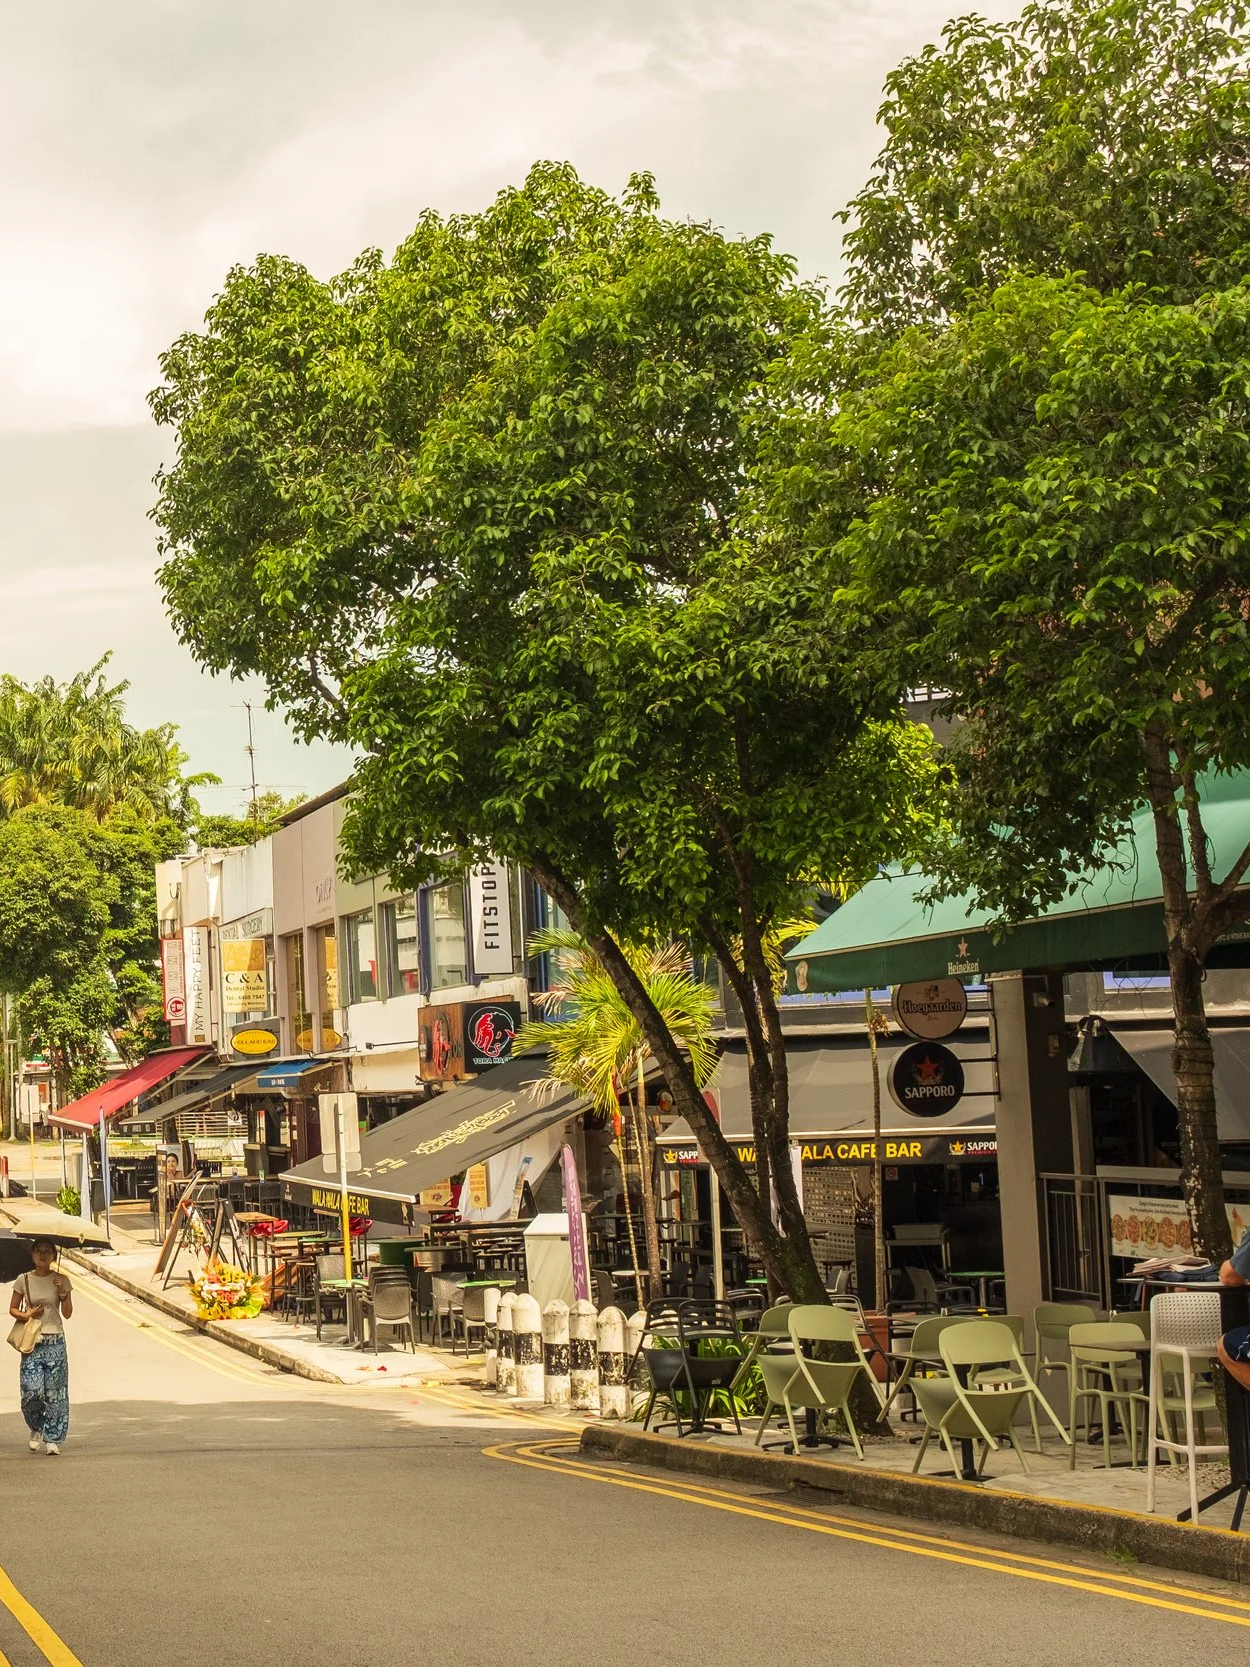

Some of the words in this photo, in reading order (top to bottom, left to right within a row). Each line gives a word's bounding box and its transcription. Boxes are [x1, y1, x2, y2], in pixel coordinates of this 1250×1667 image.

[480, 865, 500, 950] FITSTOP
[191, 929, 202, 964] FEET
[947, 962, 980, 976] Heineken
[225, 972, 234, 984] C
[239, 972, 250, 984] &
[254, 972, 264, 983] A
[193, 967, 204, 1009] HAPPY
[902, 1000, 962, 1015] Hoegaarden
[195, 1014, 204, 1031] MY
[472, 1056, 493, 1065] TORA
[904, 1084, 955, 1099] SAPPORO
[801, 1144, 835, 1160] ALA
[837, 1143, 877, 1159] CAFE
[886, 1142, 922, 1158] BAR
[966, 1140, 998, 1151] SAPPO
[678, 1150, 699, 1160] SAPP
[311, 1188, 326, 1208] WALA
[325, 1191, 341, 1210] WALA
[356, 1196, 370, 1217] BAR
